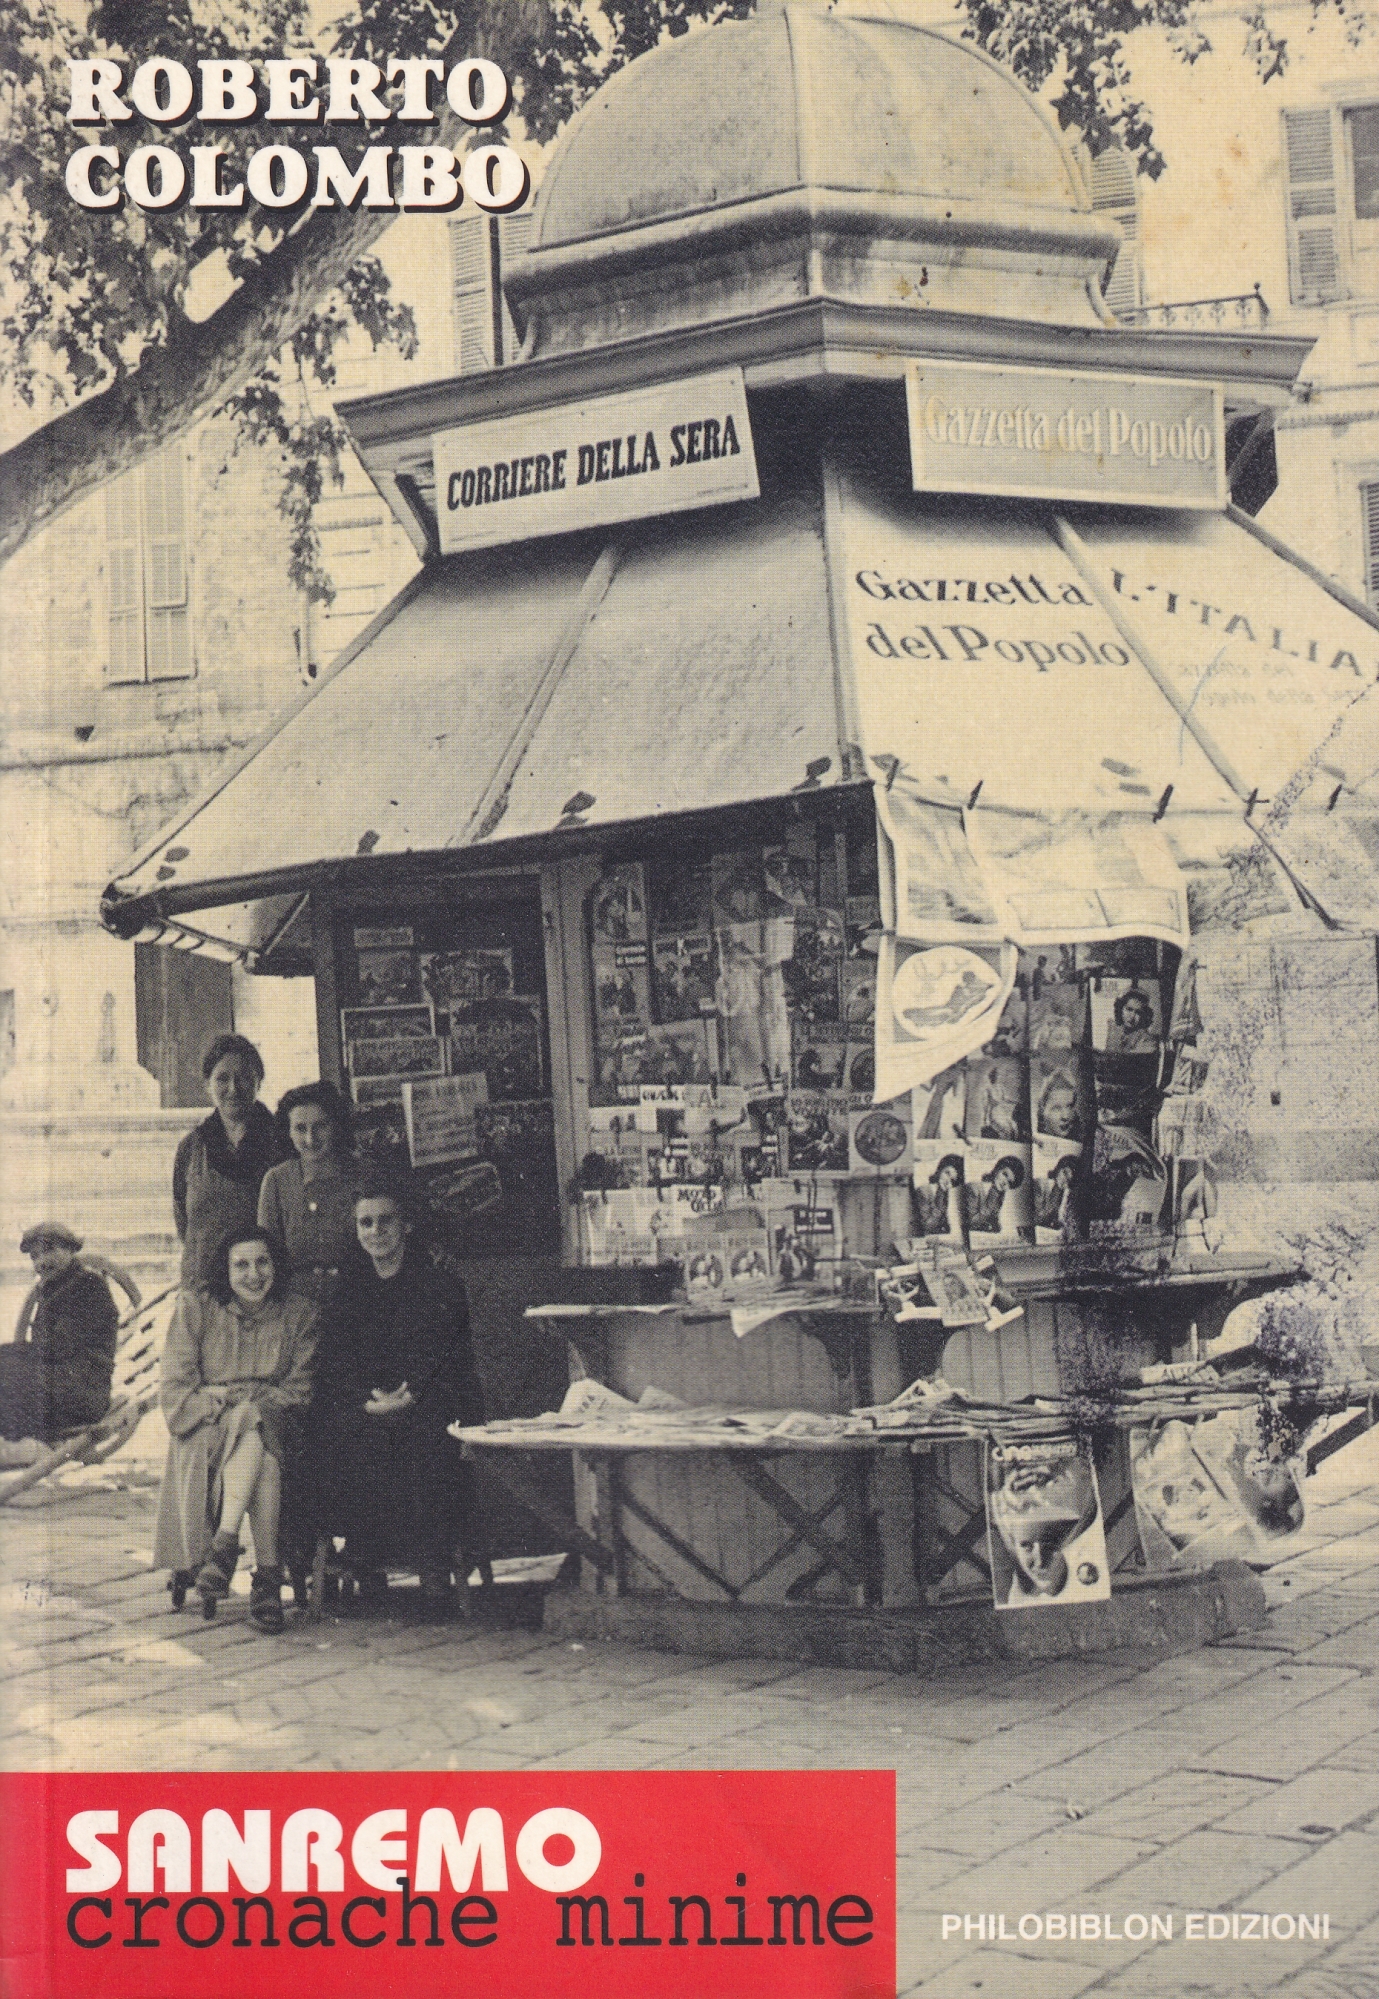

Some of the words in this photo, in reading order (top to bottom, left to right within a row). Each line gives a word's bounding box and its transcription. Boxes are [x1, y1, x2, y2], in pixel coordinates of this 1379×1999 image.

[447, 449, 567, 511] CORRIERE
[576, 430, 660, 486] DELLA
[670, 414, 740, 467] SERA
[926, 395, 1048, 450] Gazzetta
[1057, 407, 1100, 452] del
[1107, 407, 1212, 466] Popolo
[855, 570, 1093, 606] Gazzetta
[1111, 568, 1362, 677] L'ITALIA
[866, 623, 951, 660] del
[941, 624, 1130, 672] Popolo
